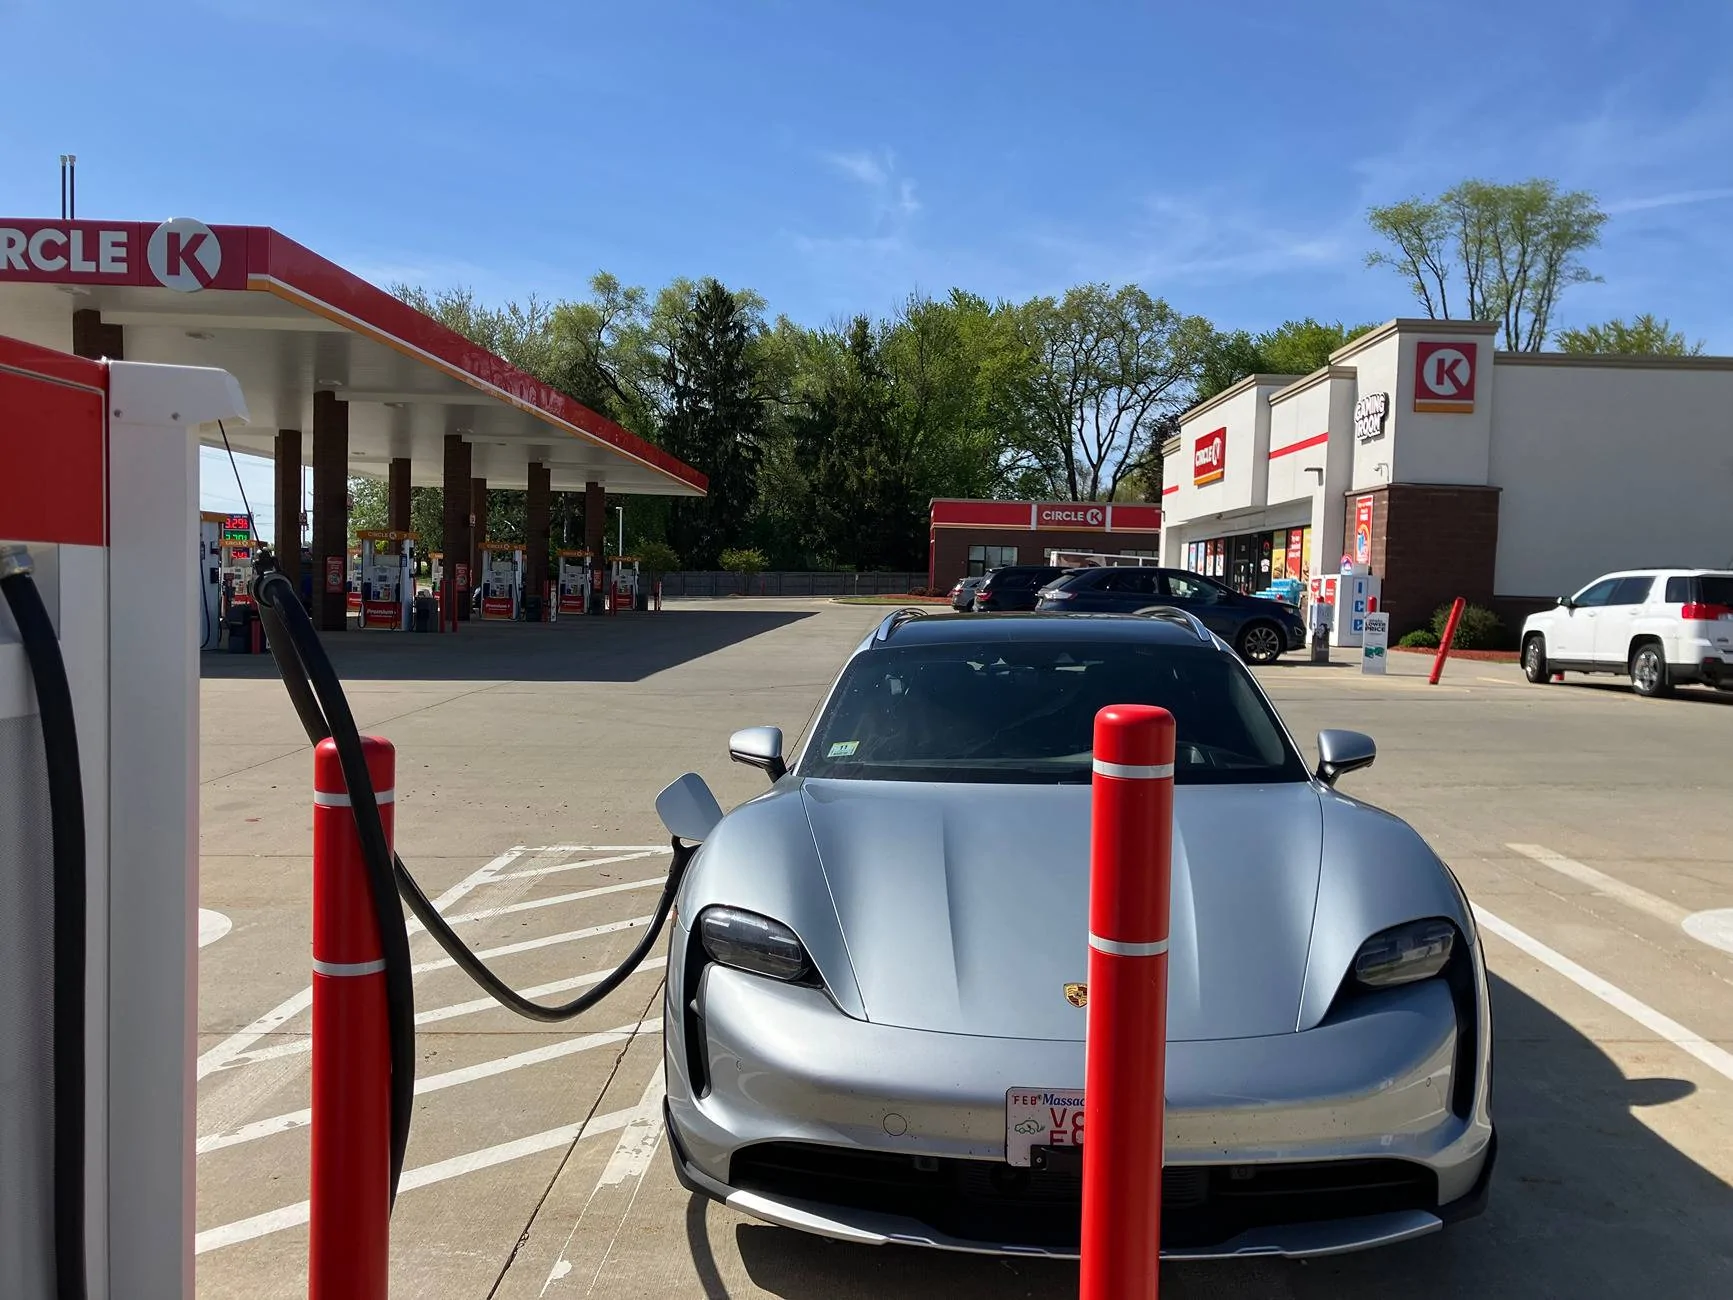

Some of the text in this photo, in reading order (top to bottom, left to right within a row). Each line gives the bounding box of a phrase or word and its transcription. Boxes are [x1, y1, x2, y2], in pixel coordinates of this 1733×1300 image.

[162, 229, 215, 289] K
[1434, 355, 1467, 393] K
[1355, 393, 1385, 420] GAMING
[1355, 413, 1381, 439] ROOM
[1196, 445, 1213, 467] CIRCLE
[1042, 510, 1102, 525] CIRCLE K
[1013, 1095, 1037, 1106] FEB
